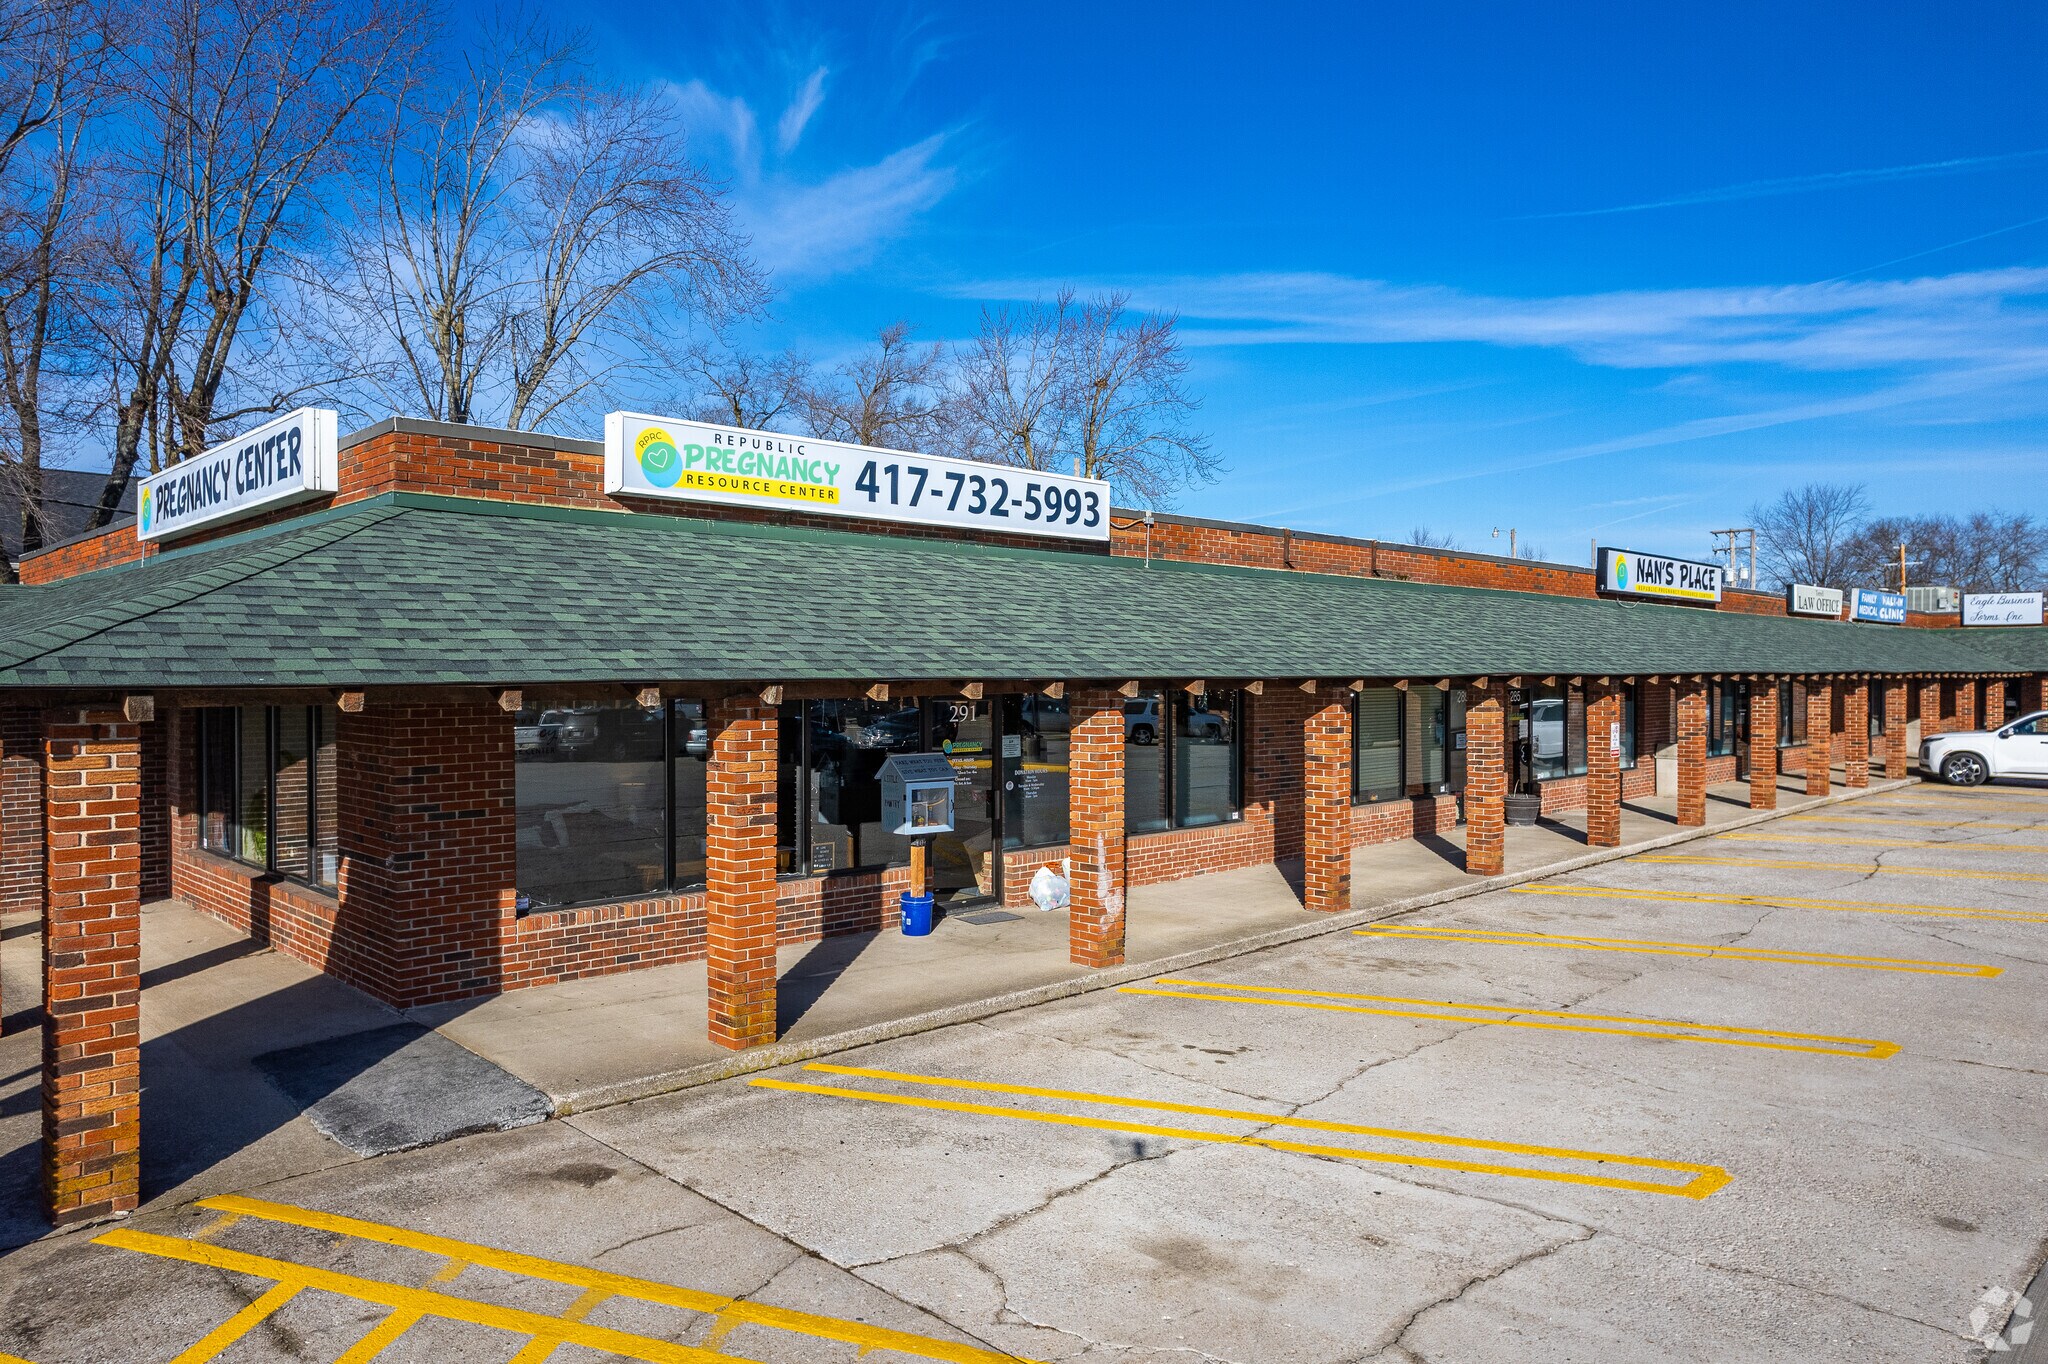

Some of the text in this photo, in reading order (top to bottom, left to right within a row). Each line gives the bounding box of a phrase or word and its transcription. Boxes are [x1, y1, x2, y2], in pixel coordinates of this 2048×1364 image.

[638, 431, 663, 449] RPRC
[714, 433, 806, 456] REPUBLIC
[156, 426, 301, 523] PREGNANCY CENTER
[683, 443, 841, 486] PREGNANCY
[686, 474, 835, 500] RESOURCE CENTER
[854, 460, 1100, 528] 417-732-5993
[1636, 557, 1716, 591] NAN'S PLACE
[1798, 595, 1840, 613] LAW OFFICE
[1858, 604, 1904, 620] MEDICAL CLINIC
[1970, 595, 2035, 609] Eagle Business
[949, 705, 977, 723] 291
